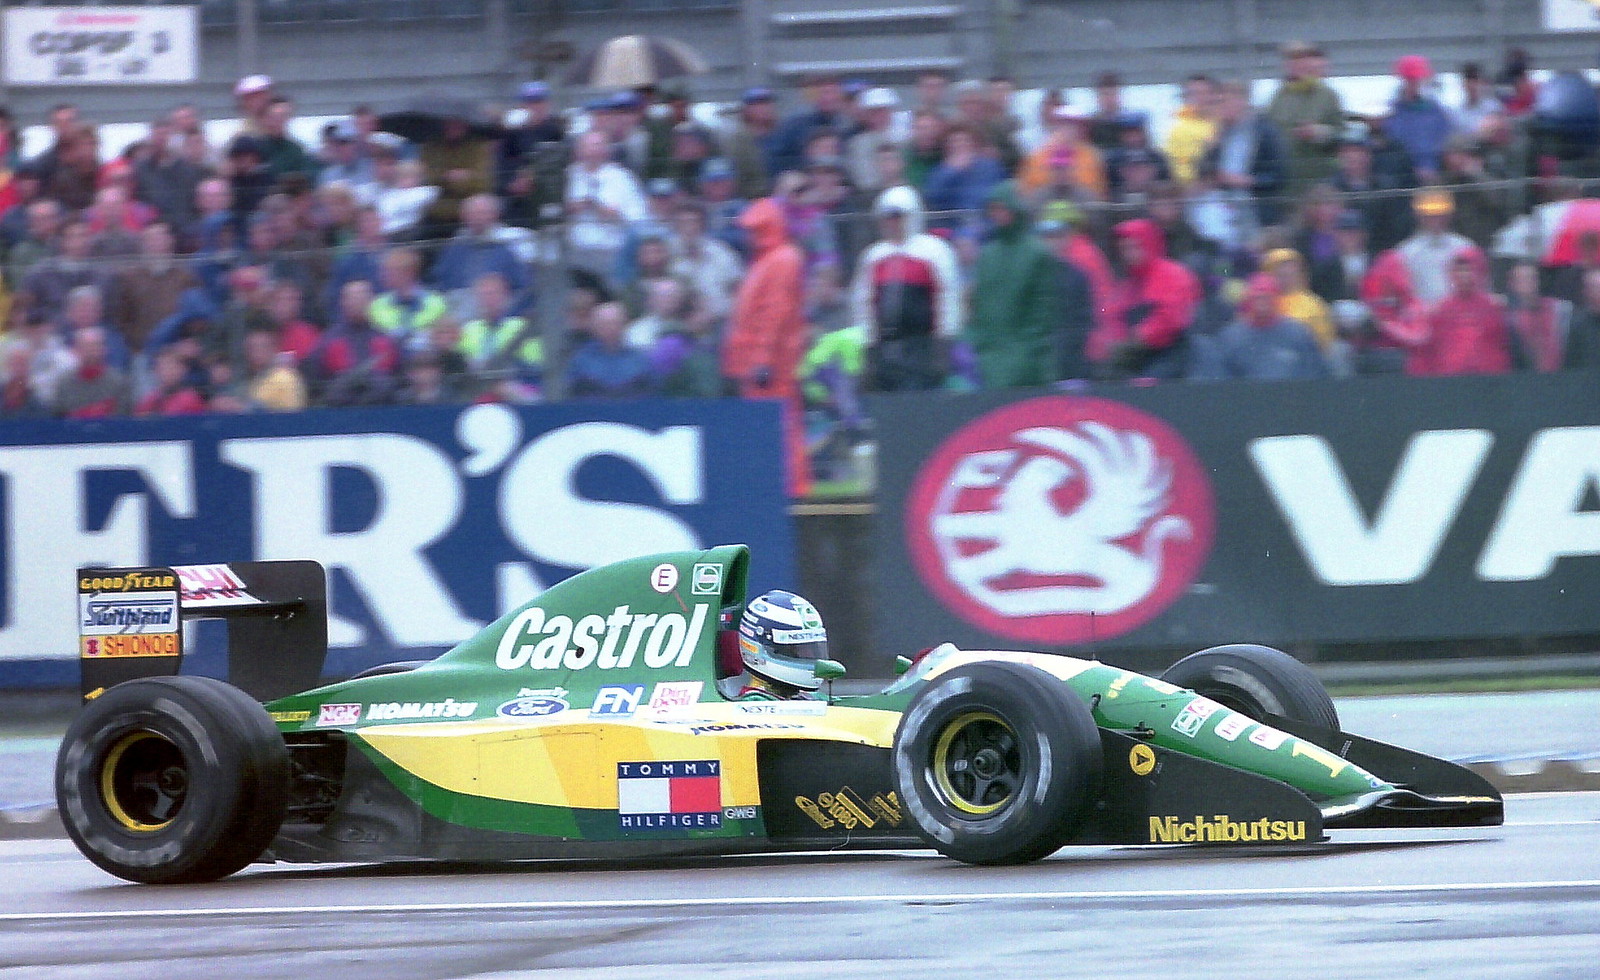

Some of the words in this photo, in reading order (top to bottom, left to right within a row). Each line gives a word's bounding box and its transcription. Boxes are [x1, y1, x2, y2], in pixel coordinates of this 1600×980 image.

[80, 572, 175, 591] GOODYEAR
[657, 567, 672, 587] E
[495, 603, 709, 670] Castrol
[366, 698, 478, 720] KOMATSU
[508, 699, 559, 717] Ford
[592, 686, 645, 714] FN
[620, 762, 718, 776] TOMMY
[622, 814, 720, 828] HILFIGER
[1149, 815, 1306, 842] Nichibutsu
